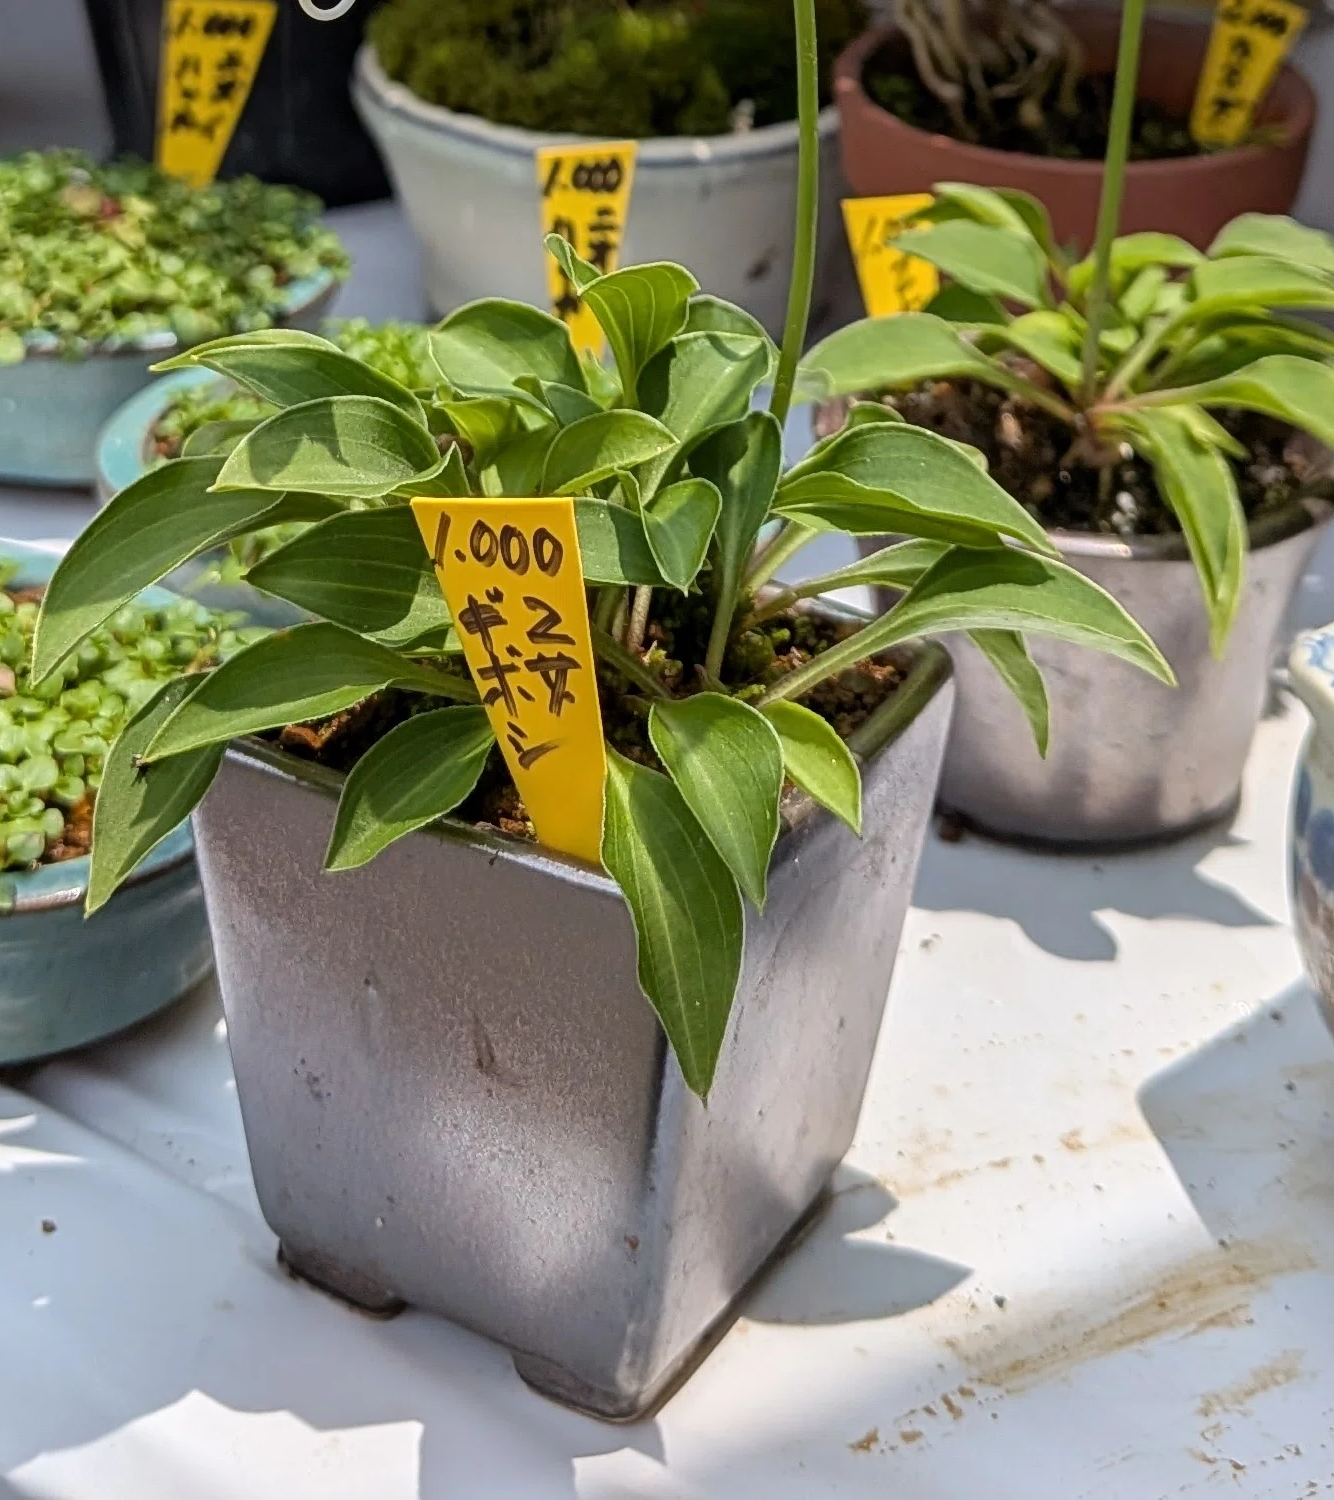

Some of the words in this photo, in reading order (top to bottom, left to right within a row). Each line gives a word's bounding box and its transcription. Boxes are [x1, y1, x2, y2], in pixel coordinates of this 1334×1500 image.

[542, 156, 623, 197] 1.000
[432, 510, 565, 578] 1.000
[457, 585, 560, 771] ギボシ
